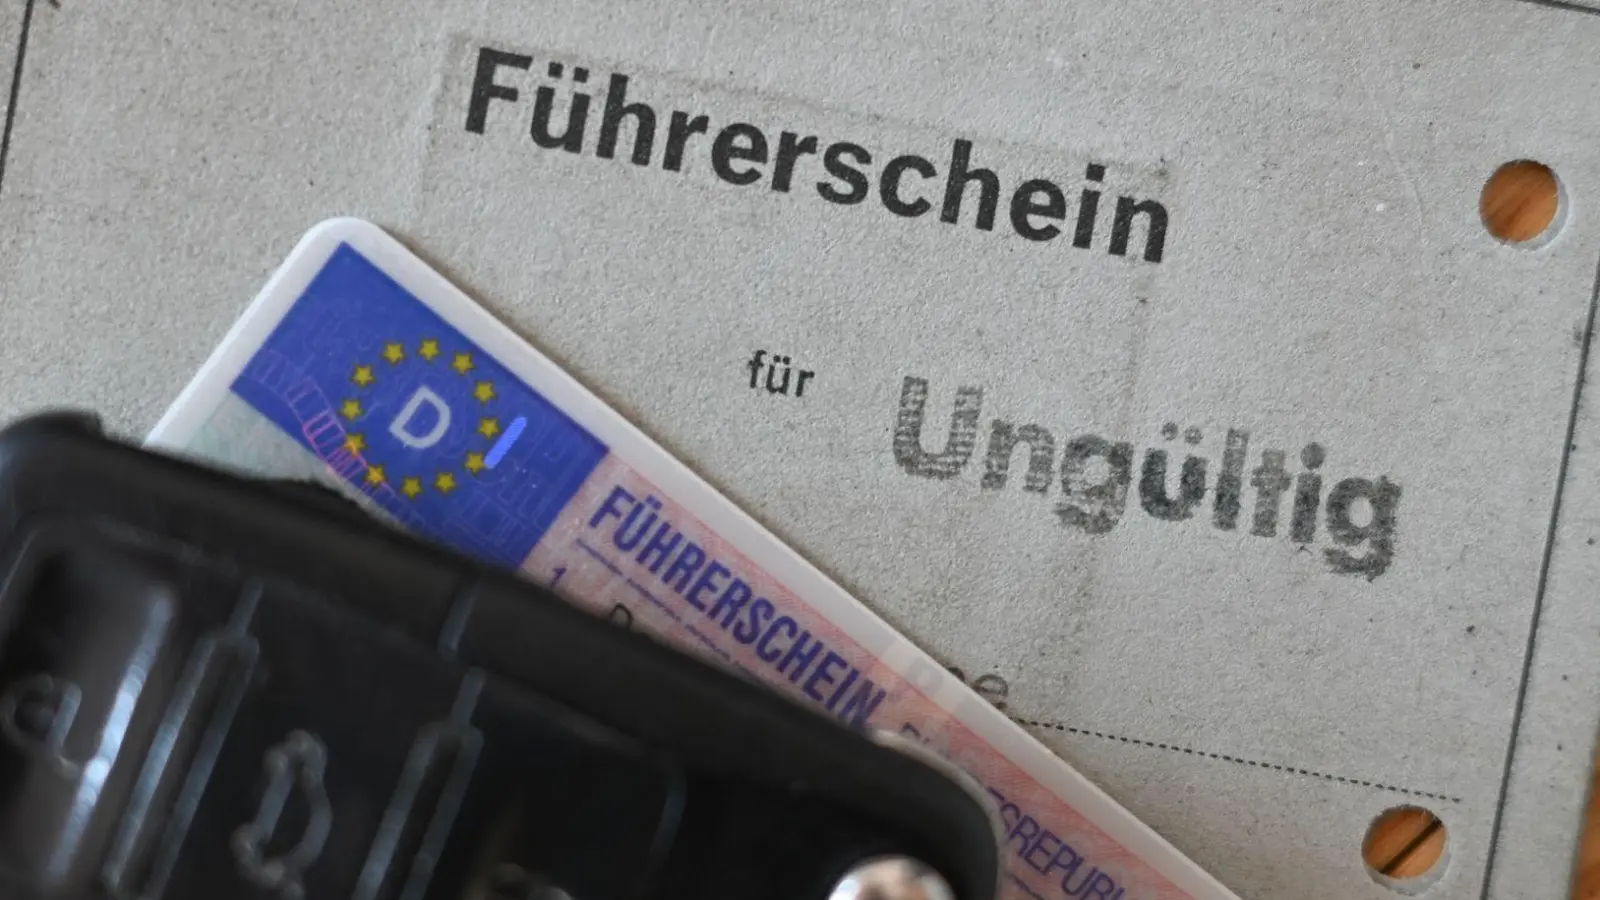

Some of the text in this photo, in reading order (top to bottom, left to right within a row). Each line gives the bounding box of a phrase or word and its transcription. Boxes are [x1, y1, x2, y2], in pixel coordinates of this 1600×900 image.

[465, 47, 1170, 263] Führerschein
[390, 385, 452, 449] D
[747, 350, 815, 397] für
[893, 376, 1401, 577] Ungültig
[589, 485, 885, 729] FÜHRERSCHEIN
